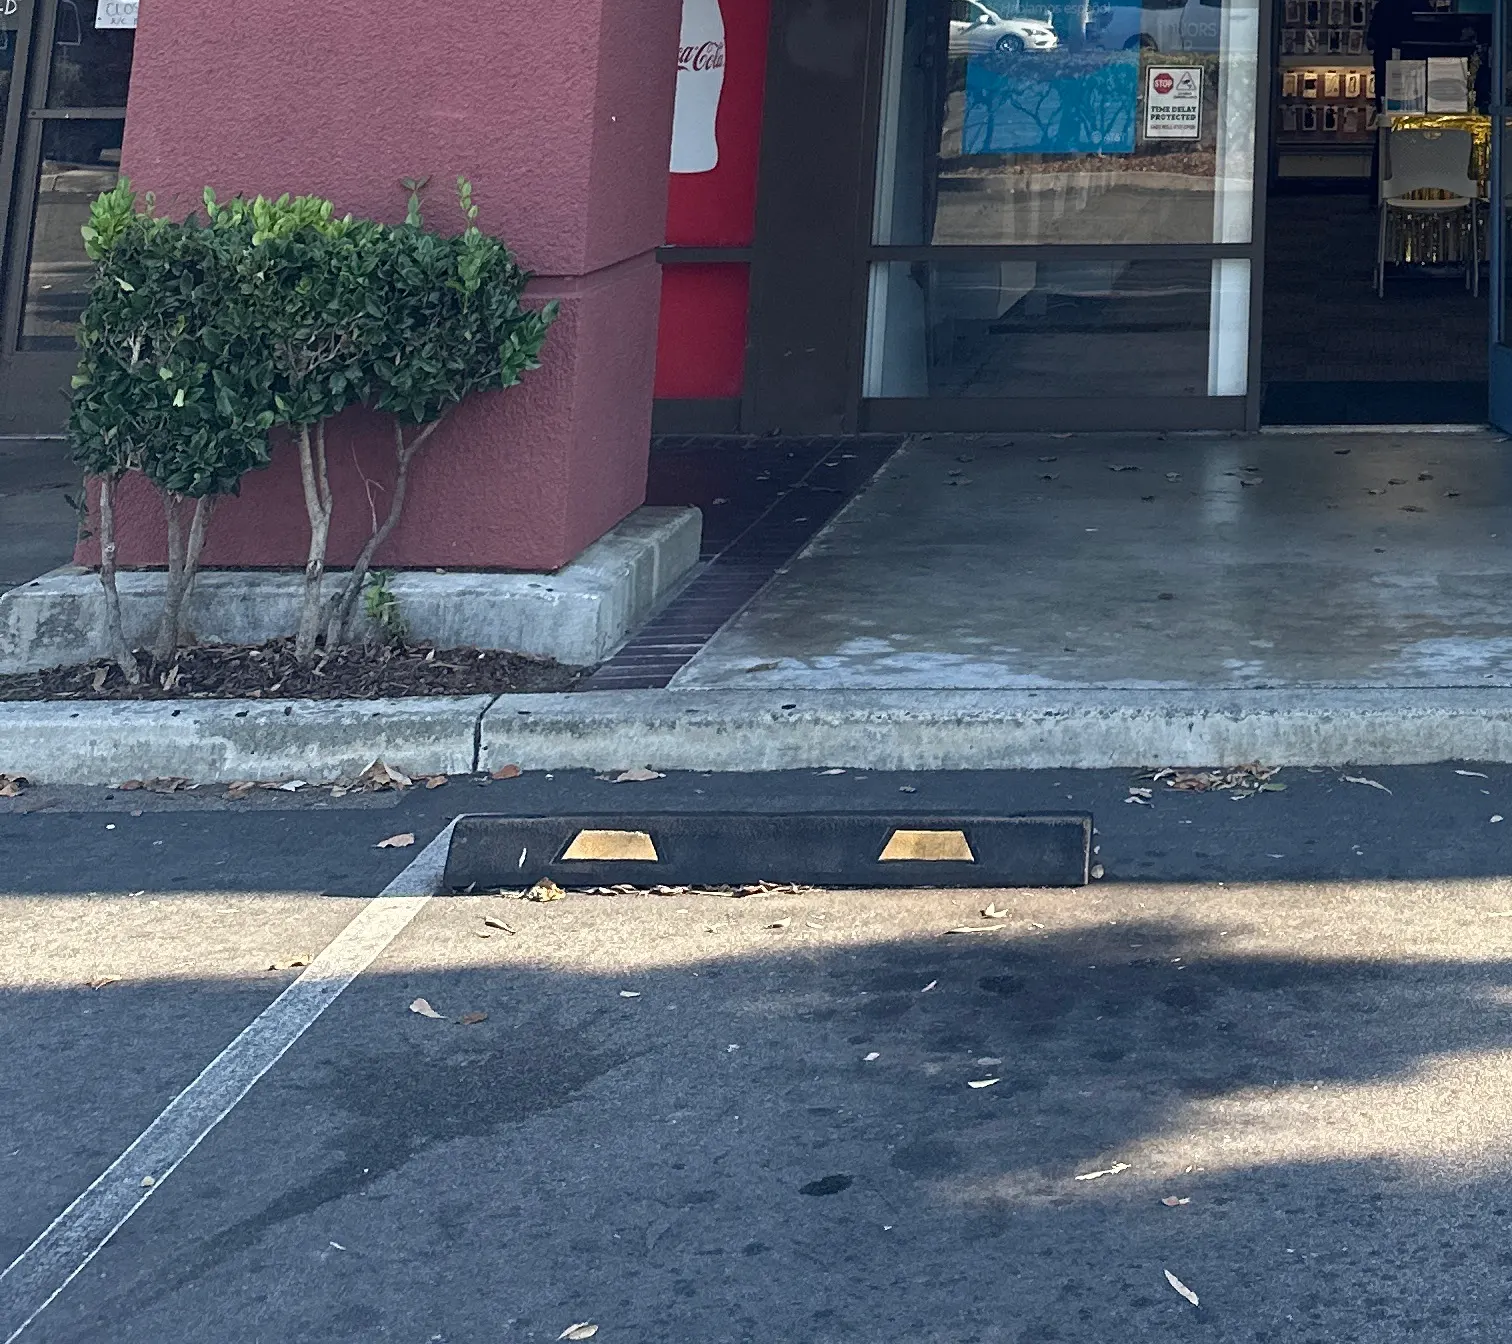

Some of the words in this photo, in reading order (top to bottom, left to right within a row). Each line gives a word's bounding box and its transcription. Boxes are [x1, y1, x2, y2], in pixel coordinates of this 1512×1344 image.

[1153, 79, 1173, 89] STOP
[1150, 105, 1171, 113] TIME
[1171, 105, 1197, 113] DELAY
[1150, 113, 1197, 122] PROTECTED
